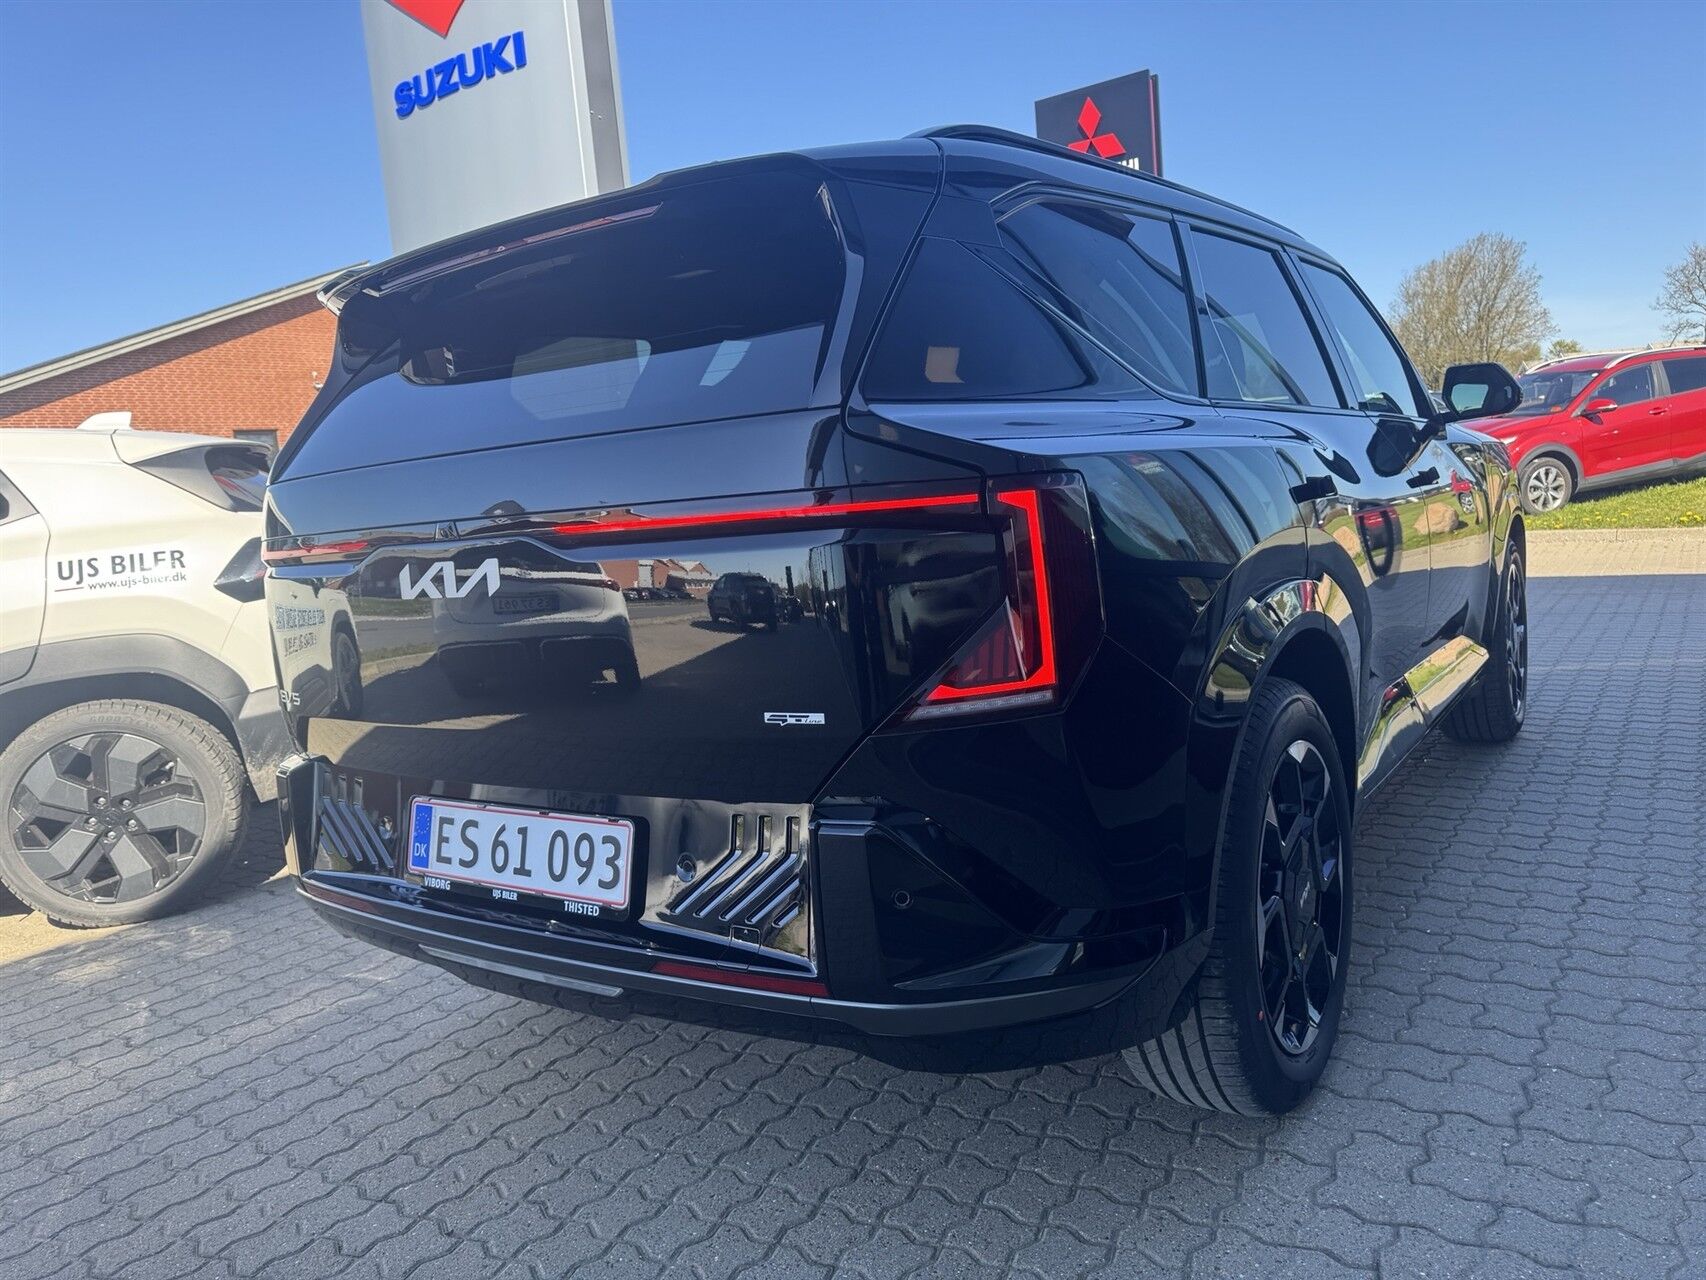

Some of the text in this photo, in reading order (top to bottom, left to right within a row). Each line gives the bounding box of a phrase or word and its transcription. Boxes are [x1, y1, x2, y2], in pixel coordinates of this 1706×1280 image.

[394, 31, 528, 119] SUZUKI
[57, 550, 187, 584] UJS BILER
[399, 558, 501, 599] KIA
[413, 842, 428, 858] DK
[436, 816, 622, 890] ES 61 093
[424, 876, 451, 891] VIBORG
[492, 889, 518, 901] UJS BILER
[564, 900, 600, 917] THISTED
